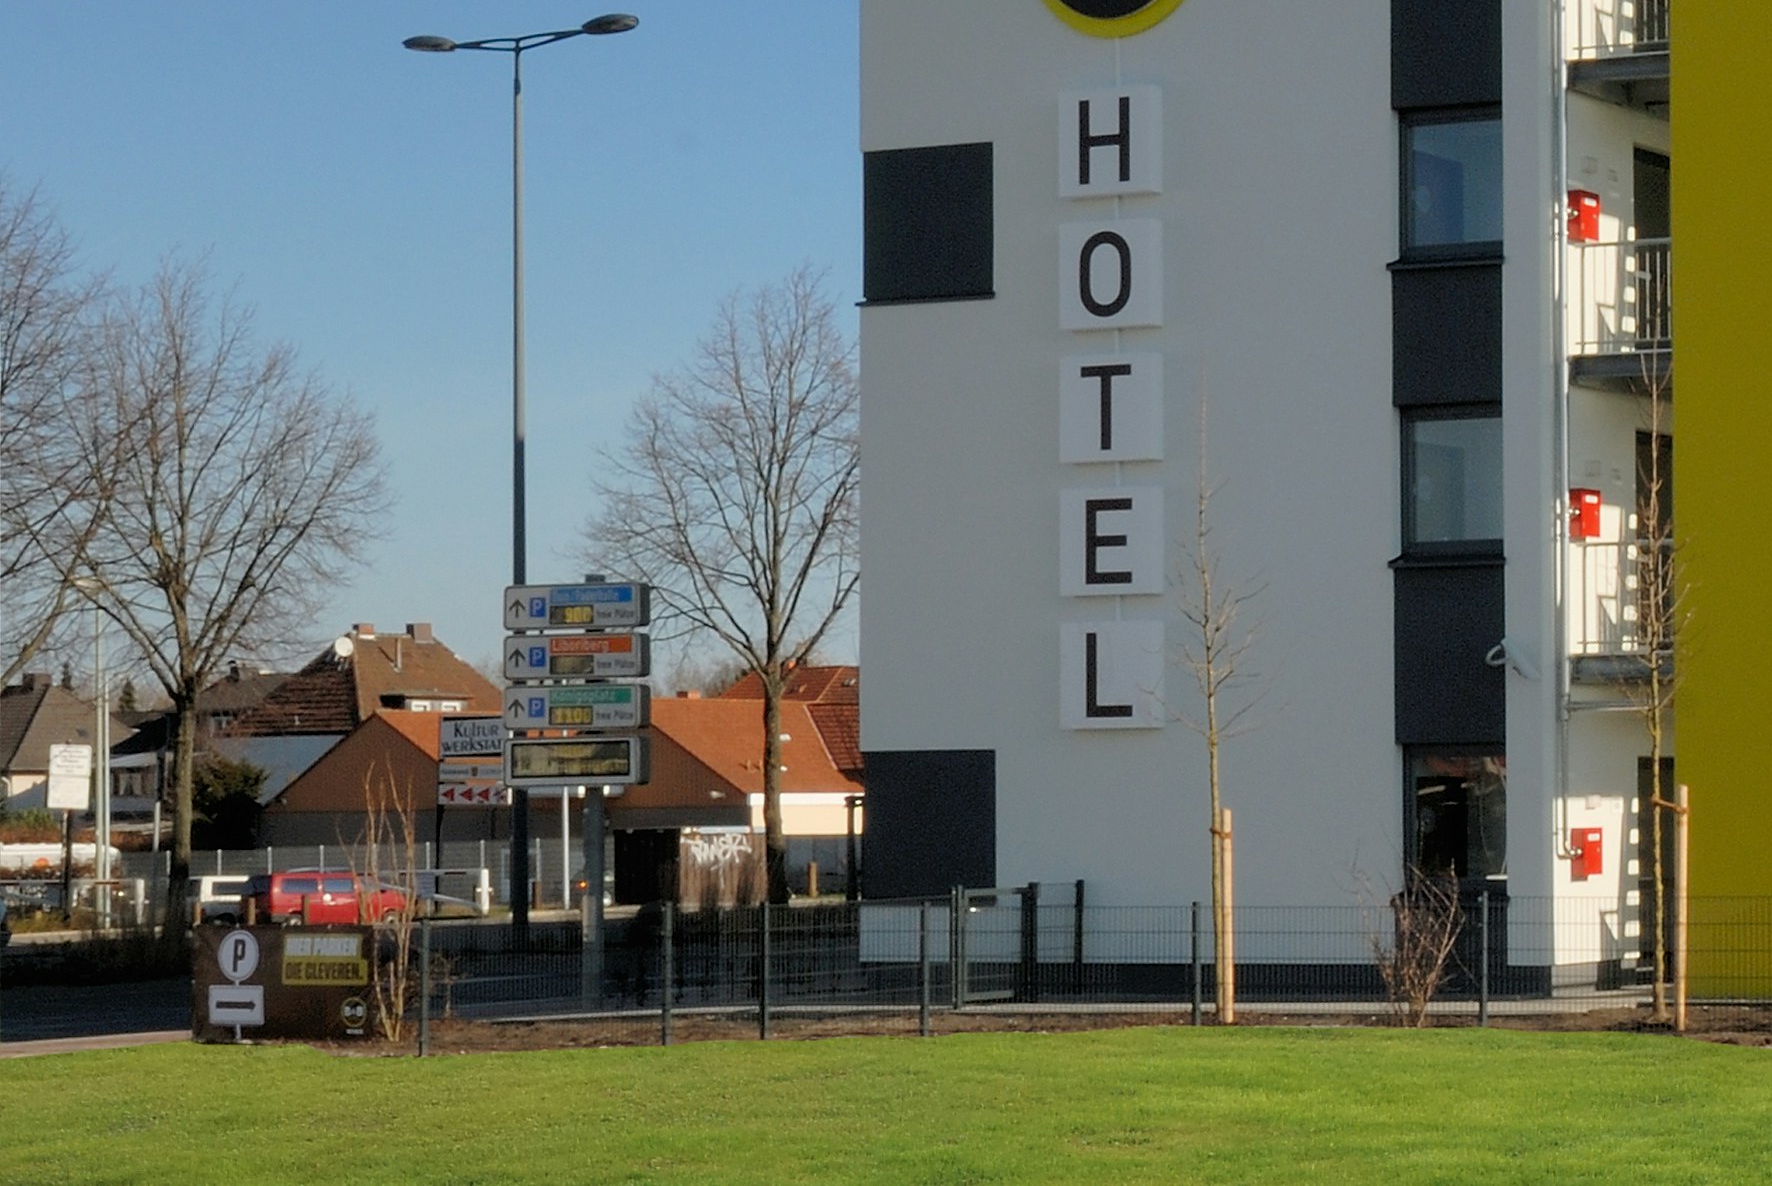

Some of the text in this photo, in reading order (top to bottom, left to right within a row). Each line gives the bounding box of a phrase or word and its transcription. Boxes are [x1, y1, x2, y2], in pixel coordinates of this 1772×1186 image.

[1079, 96, 1133, 717] HOTEL
[442, 738, 502, 752] WERKSTAT
[232, 938, 246, 973] P
